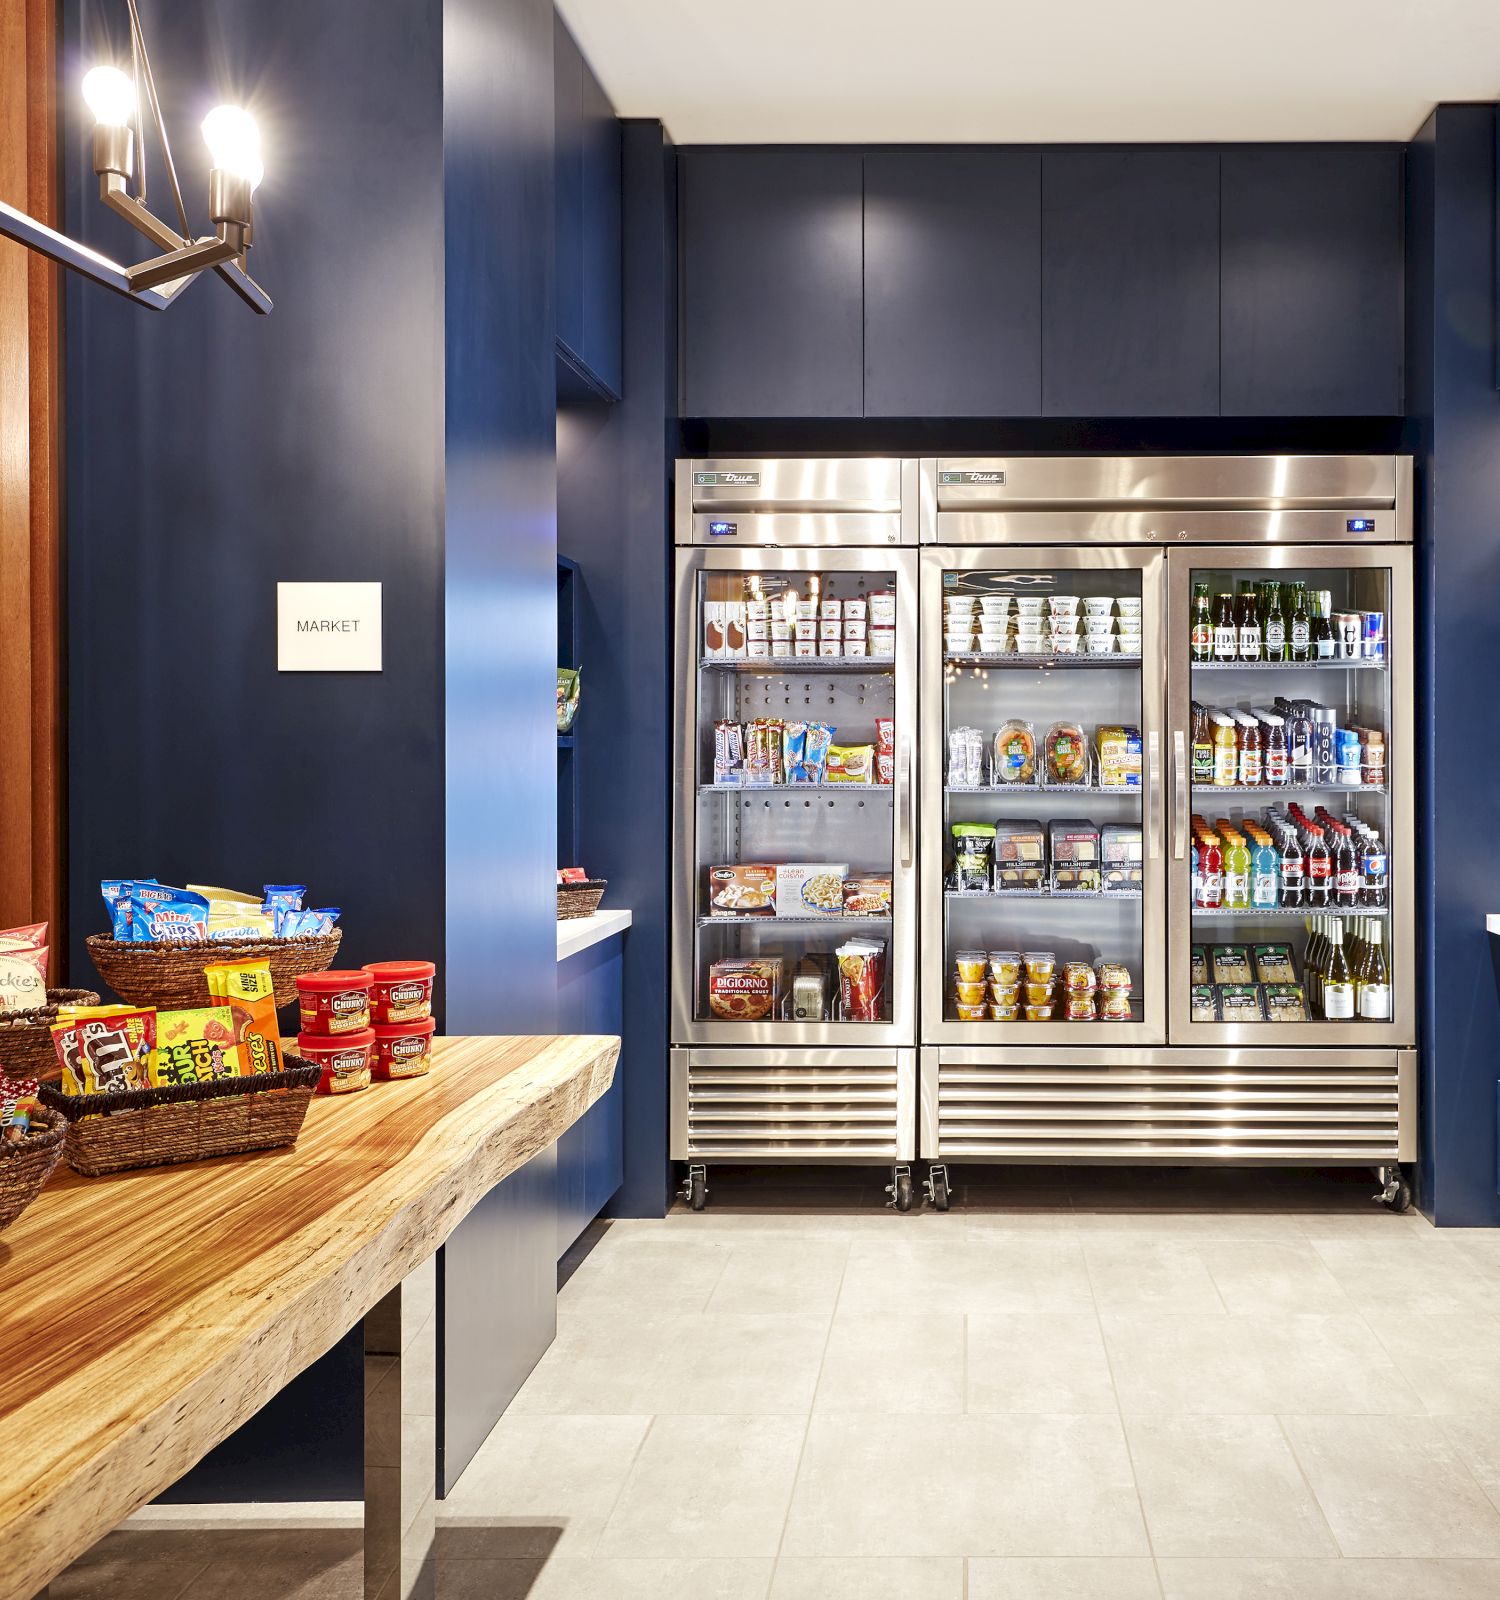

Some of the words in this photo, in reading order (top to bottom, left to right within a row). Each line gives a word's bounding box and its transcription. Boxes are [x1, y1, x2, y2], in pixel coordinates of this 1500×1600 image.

[297, 620, 361, 632] MARKET
[141, 889, 156, 899] BIG
[155, 911, 191, 923] Mini
[150, 922, 197, 937] Chips
[240, 972, 249, 992] KING
[250, 973, 259, 992] SIZE
[392, 990, 422, 1000] CHUNKY
[333, 999, 364, 1010] CHUNKY
[126, 1018, 138, 1043] SHARE
[134, 1018, 144, 1034] SIZE
[394, 1044, 424, 1055] CHUNKY
[172, 1046, 198, 1085] OUR
[191, 1040, 214, 1081] ATCH
[334, 1057, 365, 1069] CHUNKY
